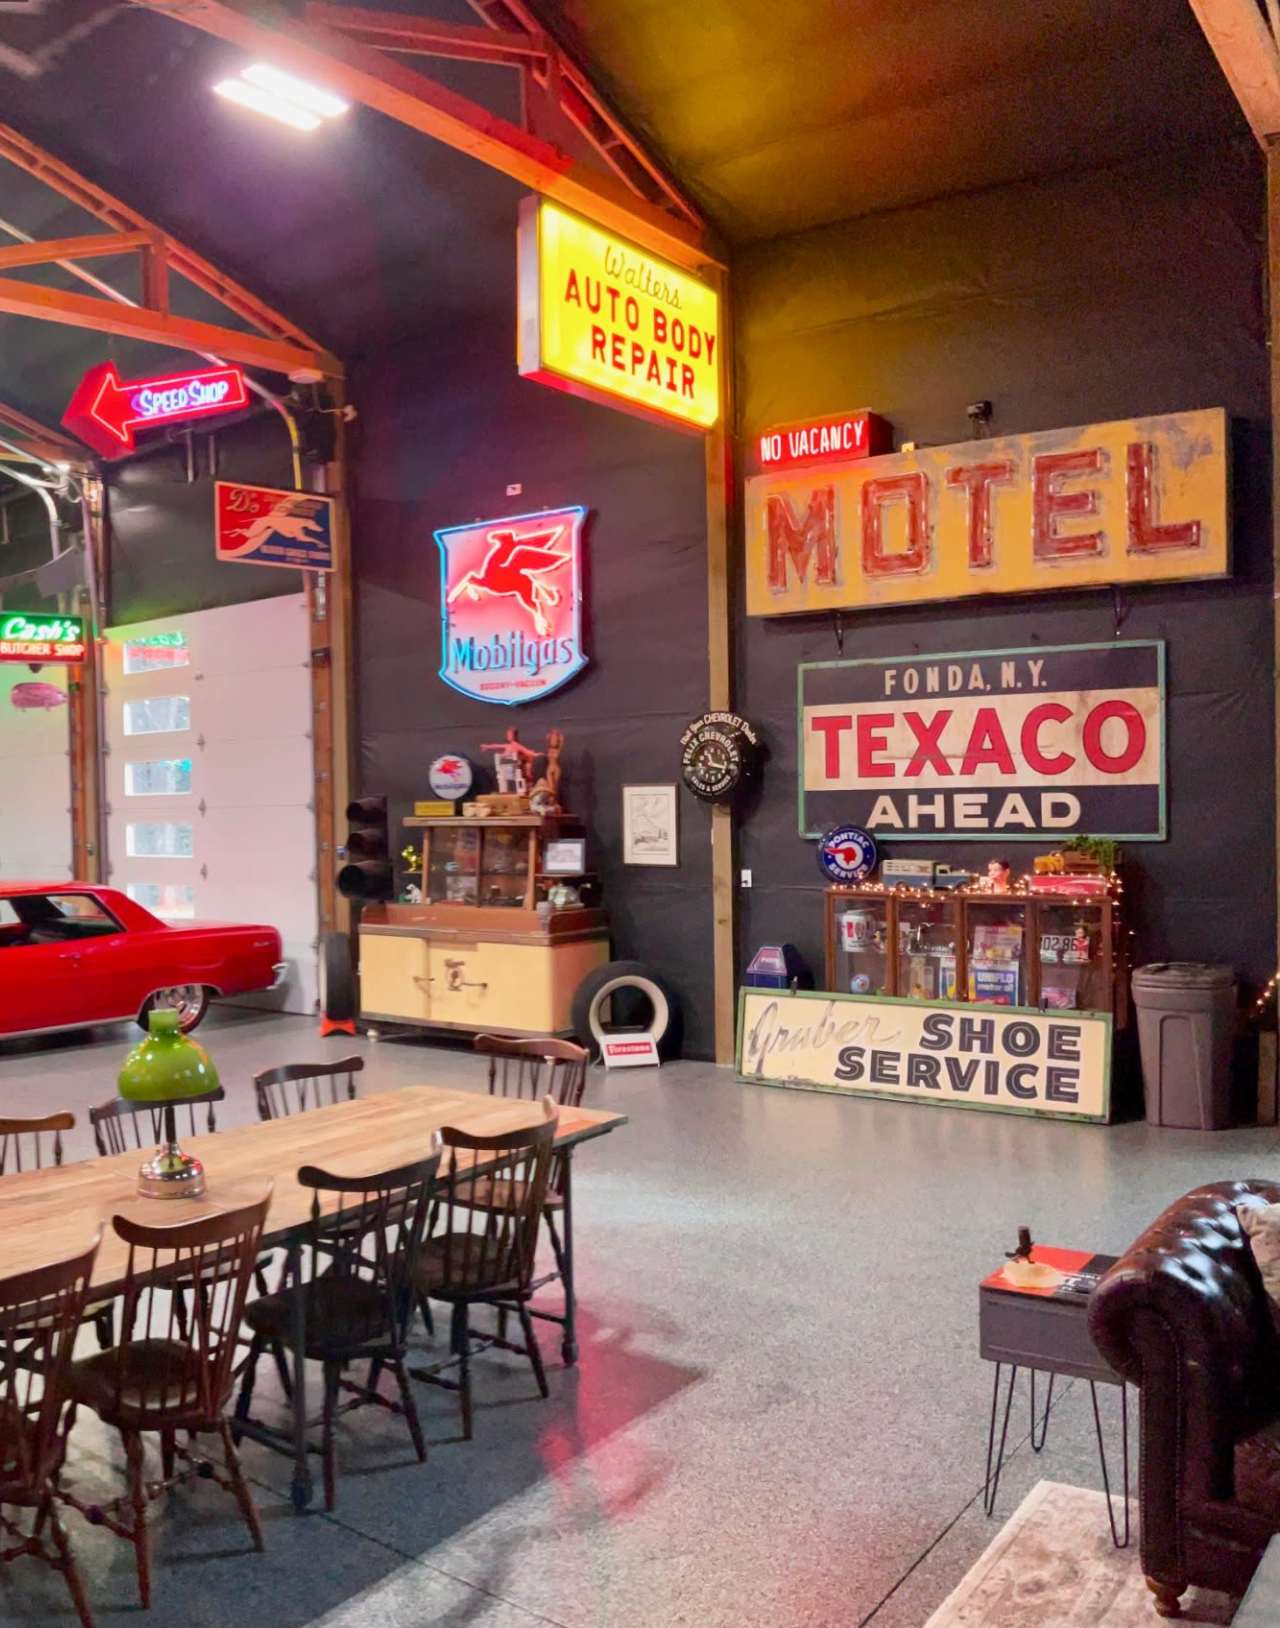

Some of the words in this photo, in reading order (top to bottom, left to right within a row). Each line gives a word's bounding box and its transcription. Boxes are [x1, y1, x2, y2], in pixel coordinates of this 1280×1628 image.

[604, 245, 682, 310] Walters
[563, 268, 641, 332] AUTO
[652, 307, 718, 366] BODY
[590, 325, 695, 398] REPAIR
[136, 388, 189, 416] SPEED
[189, 380, 229, 404] SHOP
[760, 435, 782, 463] NO
[787, 419, 865, 457] VACANCY
[767, 441, 1203, 593] MOTEL
[4, 617, 80, 641] Cash's
[451, 632, 574, 676] Mobilgas
[885, 663, 992, 696] FONDA,
[704, 713, 743, 726] CHEVROLET
[810, 700, 1148, 780] TEXACO
[683, 738, 700, 764] FELIX
[699, 731, 739, 762] CHEVROLET
[865, 792, 1082, 829] AHEAD
[829, 832, 870, 848] PONTIAC
[919, 1013, 1082, 1062] SHOE
[834, 1047, 1080, 1103] SERVICE
